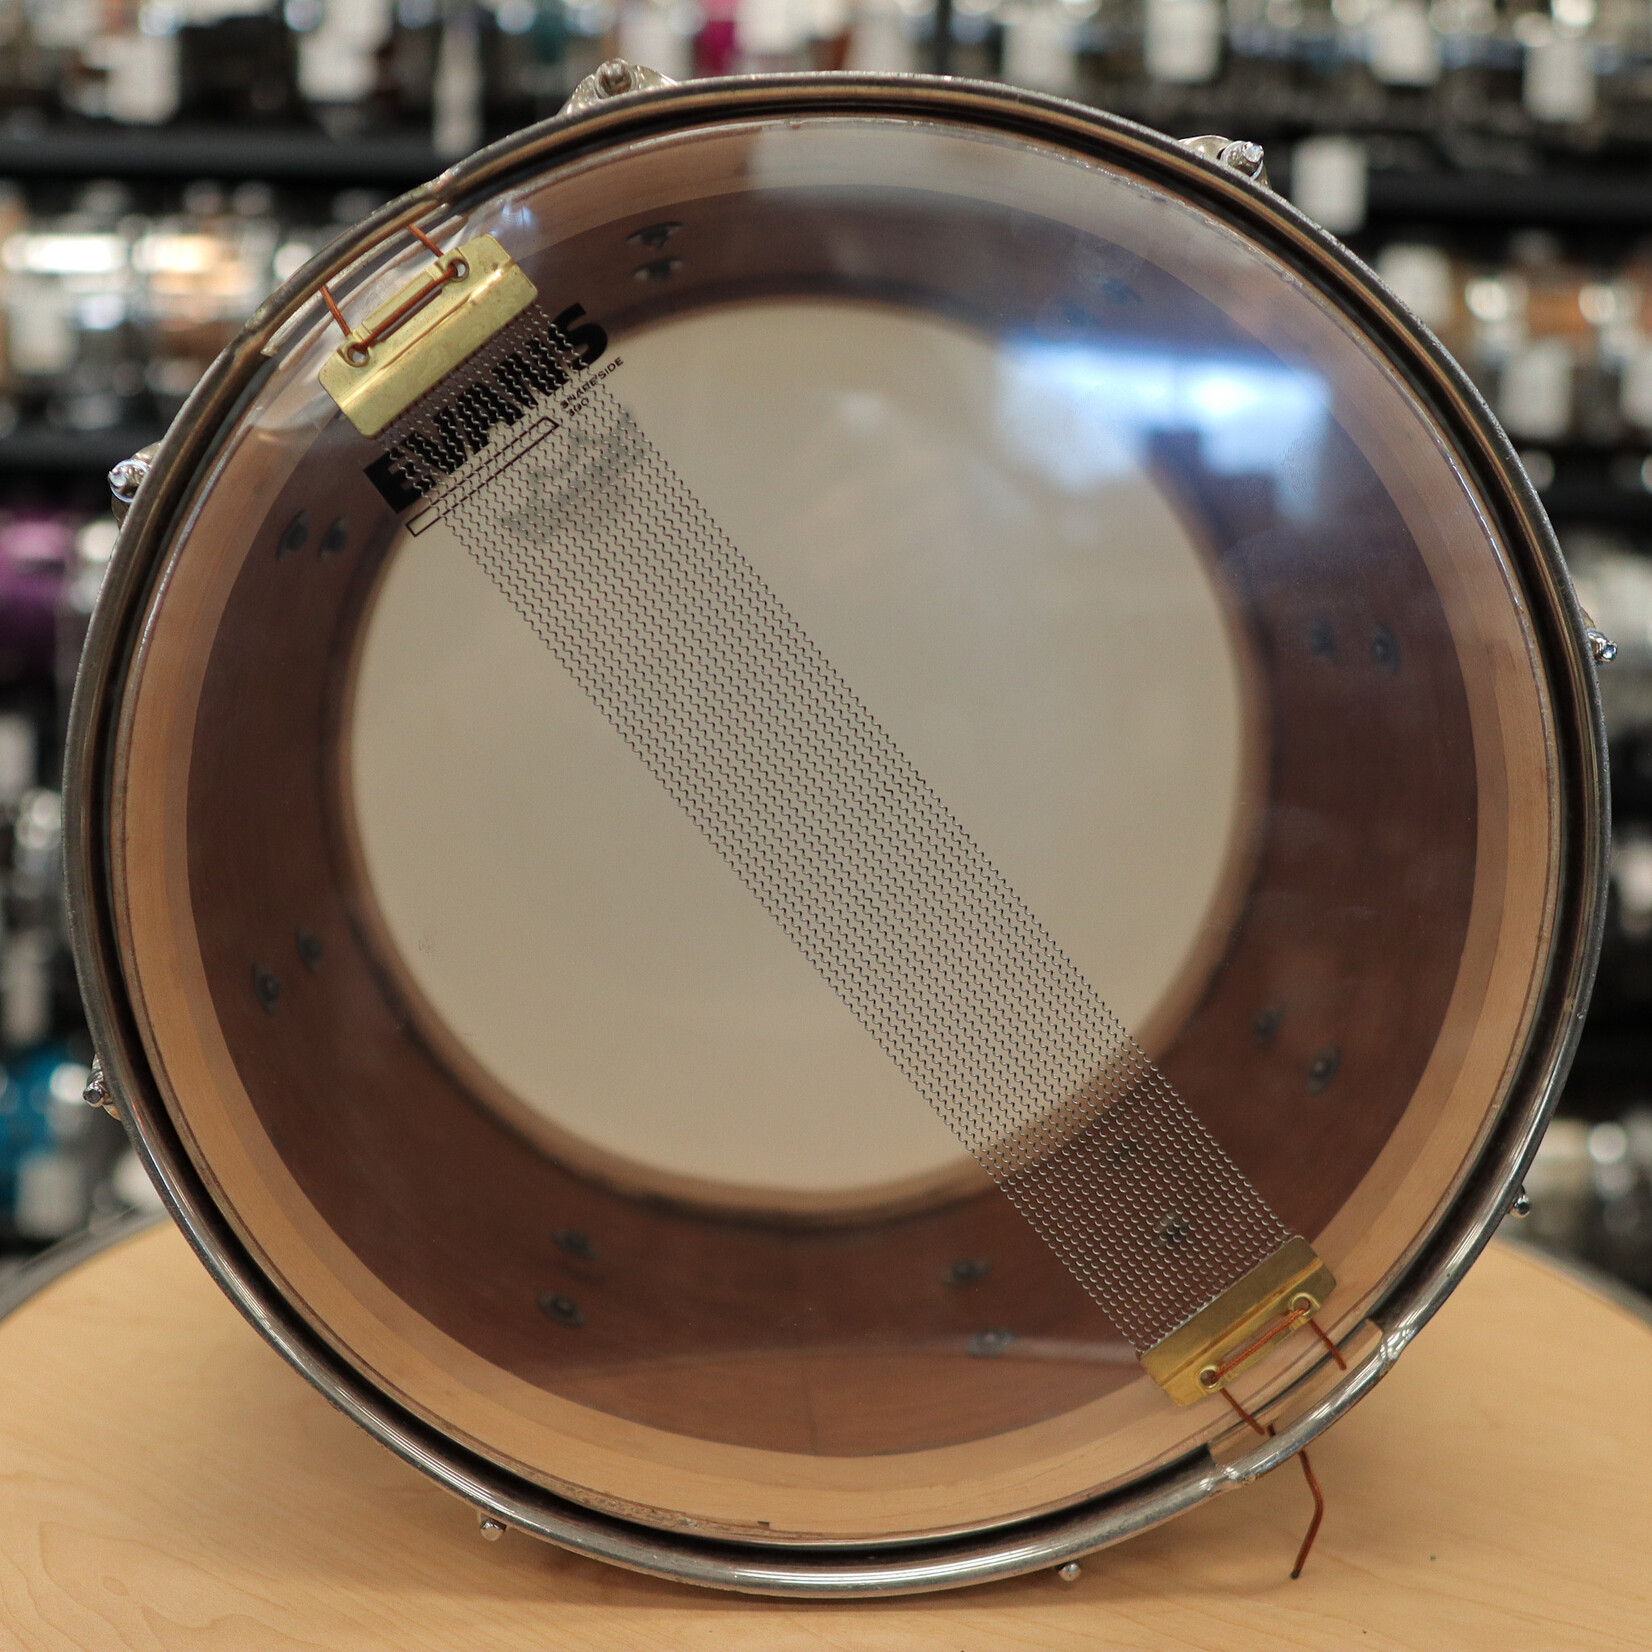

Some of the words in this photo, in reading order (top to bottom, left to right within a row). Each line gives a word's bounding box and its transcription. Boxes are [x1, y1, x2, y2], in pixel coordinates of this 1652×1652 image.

[364, 303, 608, 514] EVANS
[561, 375, 597, 409] SNARE
[597, 356, 624, 380] SIDE
